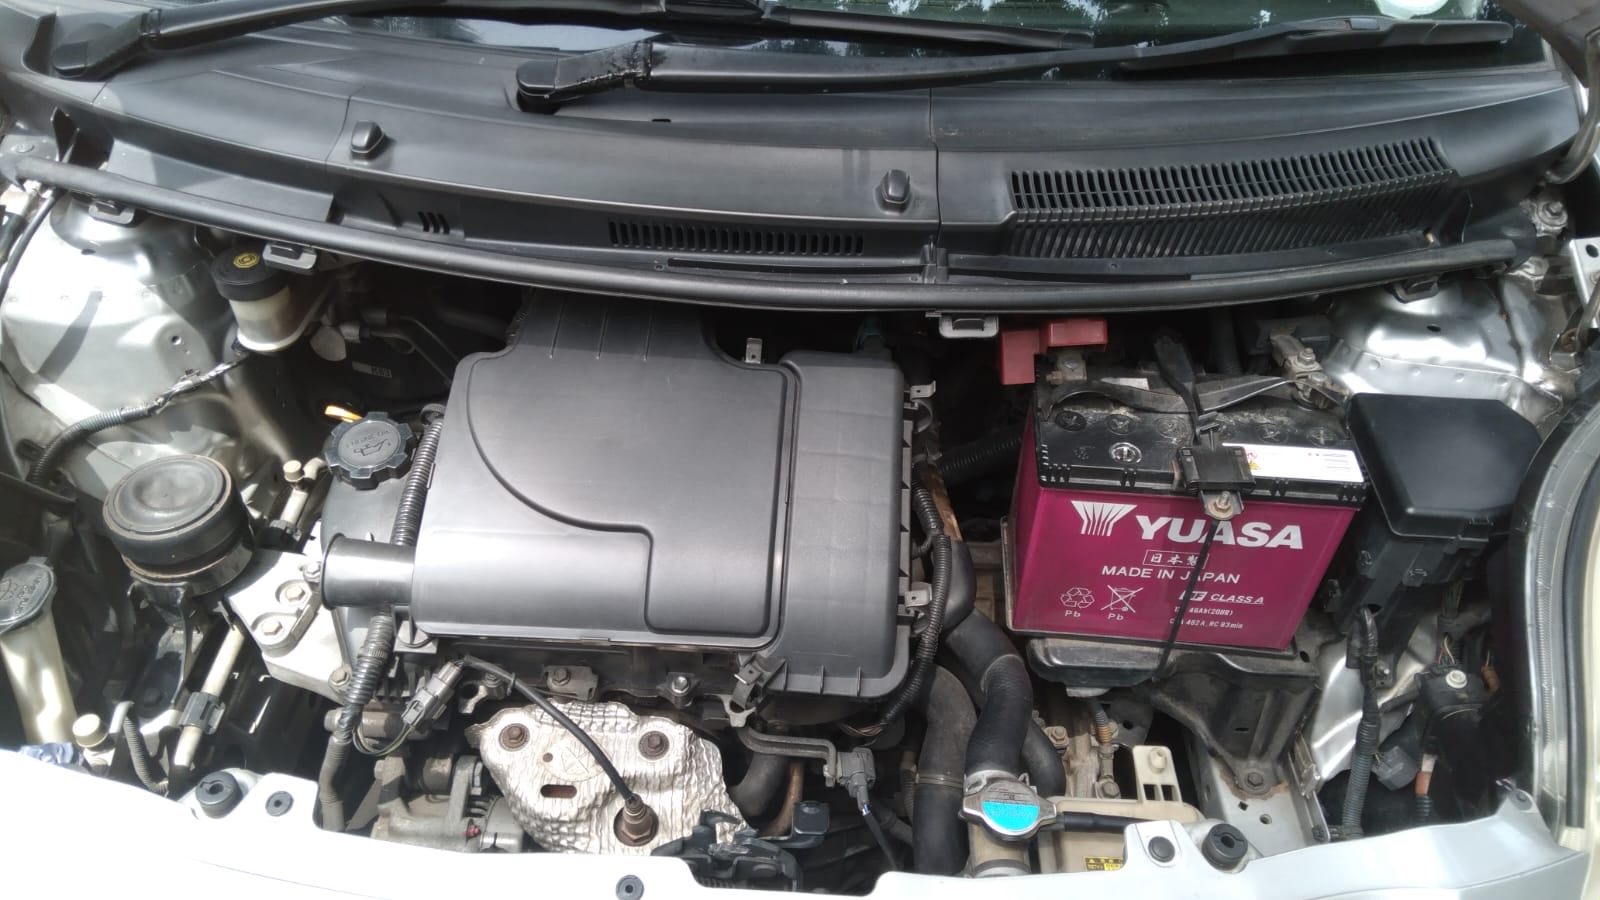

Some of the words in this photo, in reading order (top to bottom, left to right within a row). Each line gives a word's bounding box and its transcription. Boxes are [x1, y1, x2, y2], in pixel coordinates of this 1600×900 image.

[1135, 514, 1304, 549] YUASA
[1101, 565, 1153, 578] MADE
[1157, 569, 1175, 580] IN
[1180, 571, 1241, 584] JPAN
[1210, 593, 1254, 604] CLASS
[1254, 596, 1264, 605] A
[1064, 609, 1081, 618] Pb
[1107, 612, 1124, 621] Pb
